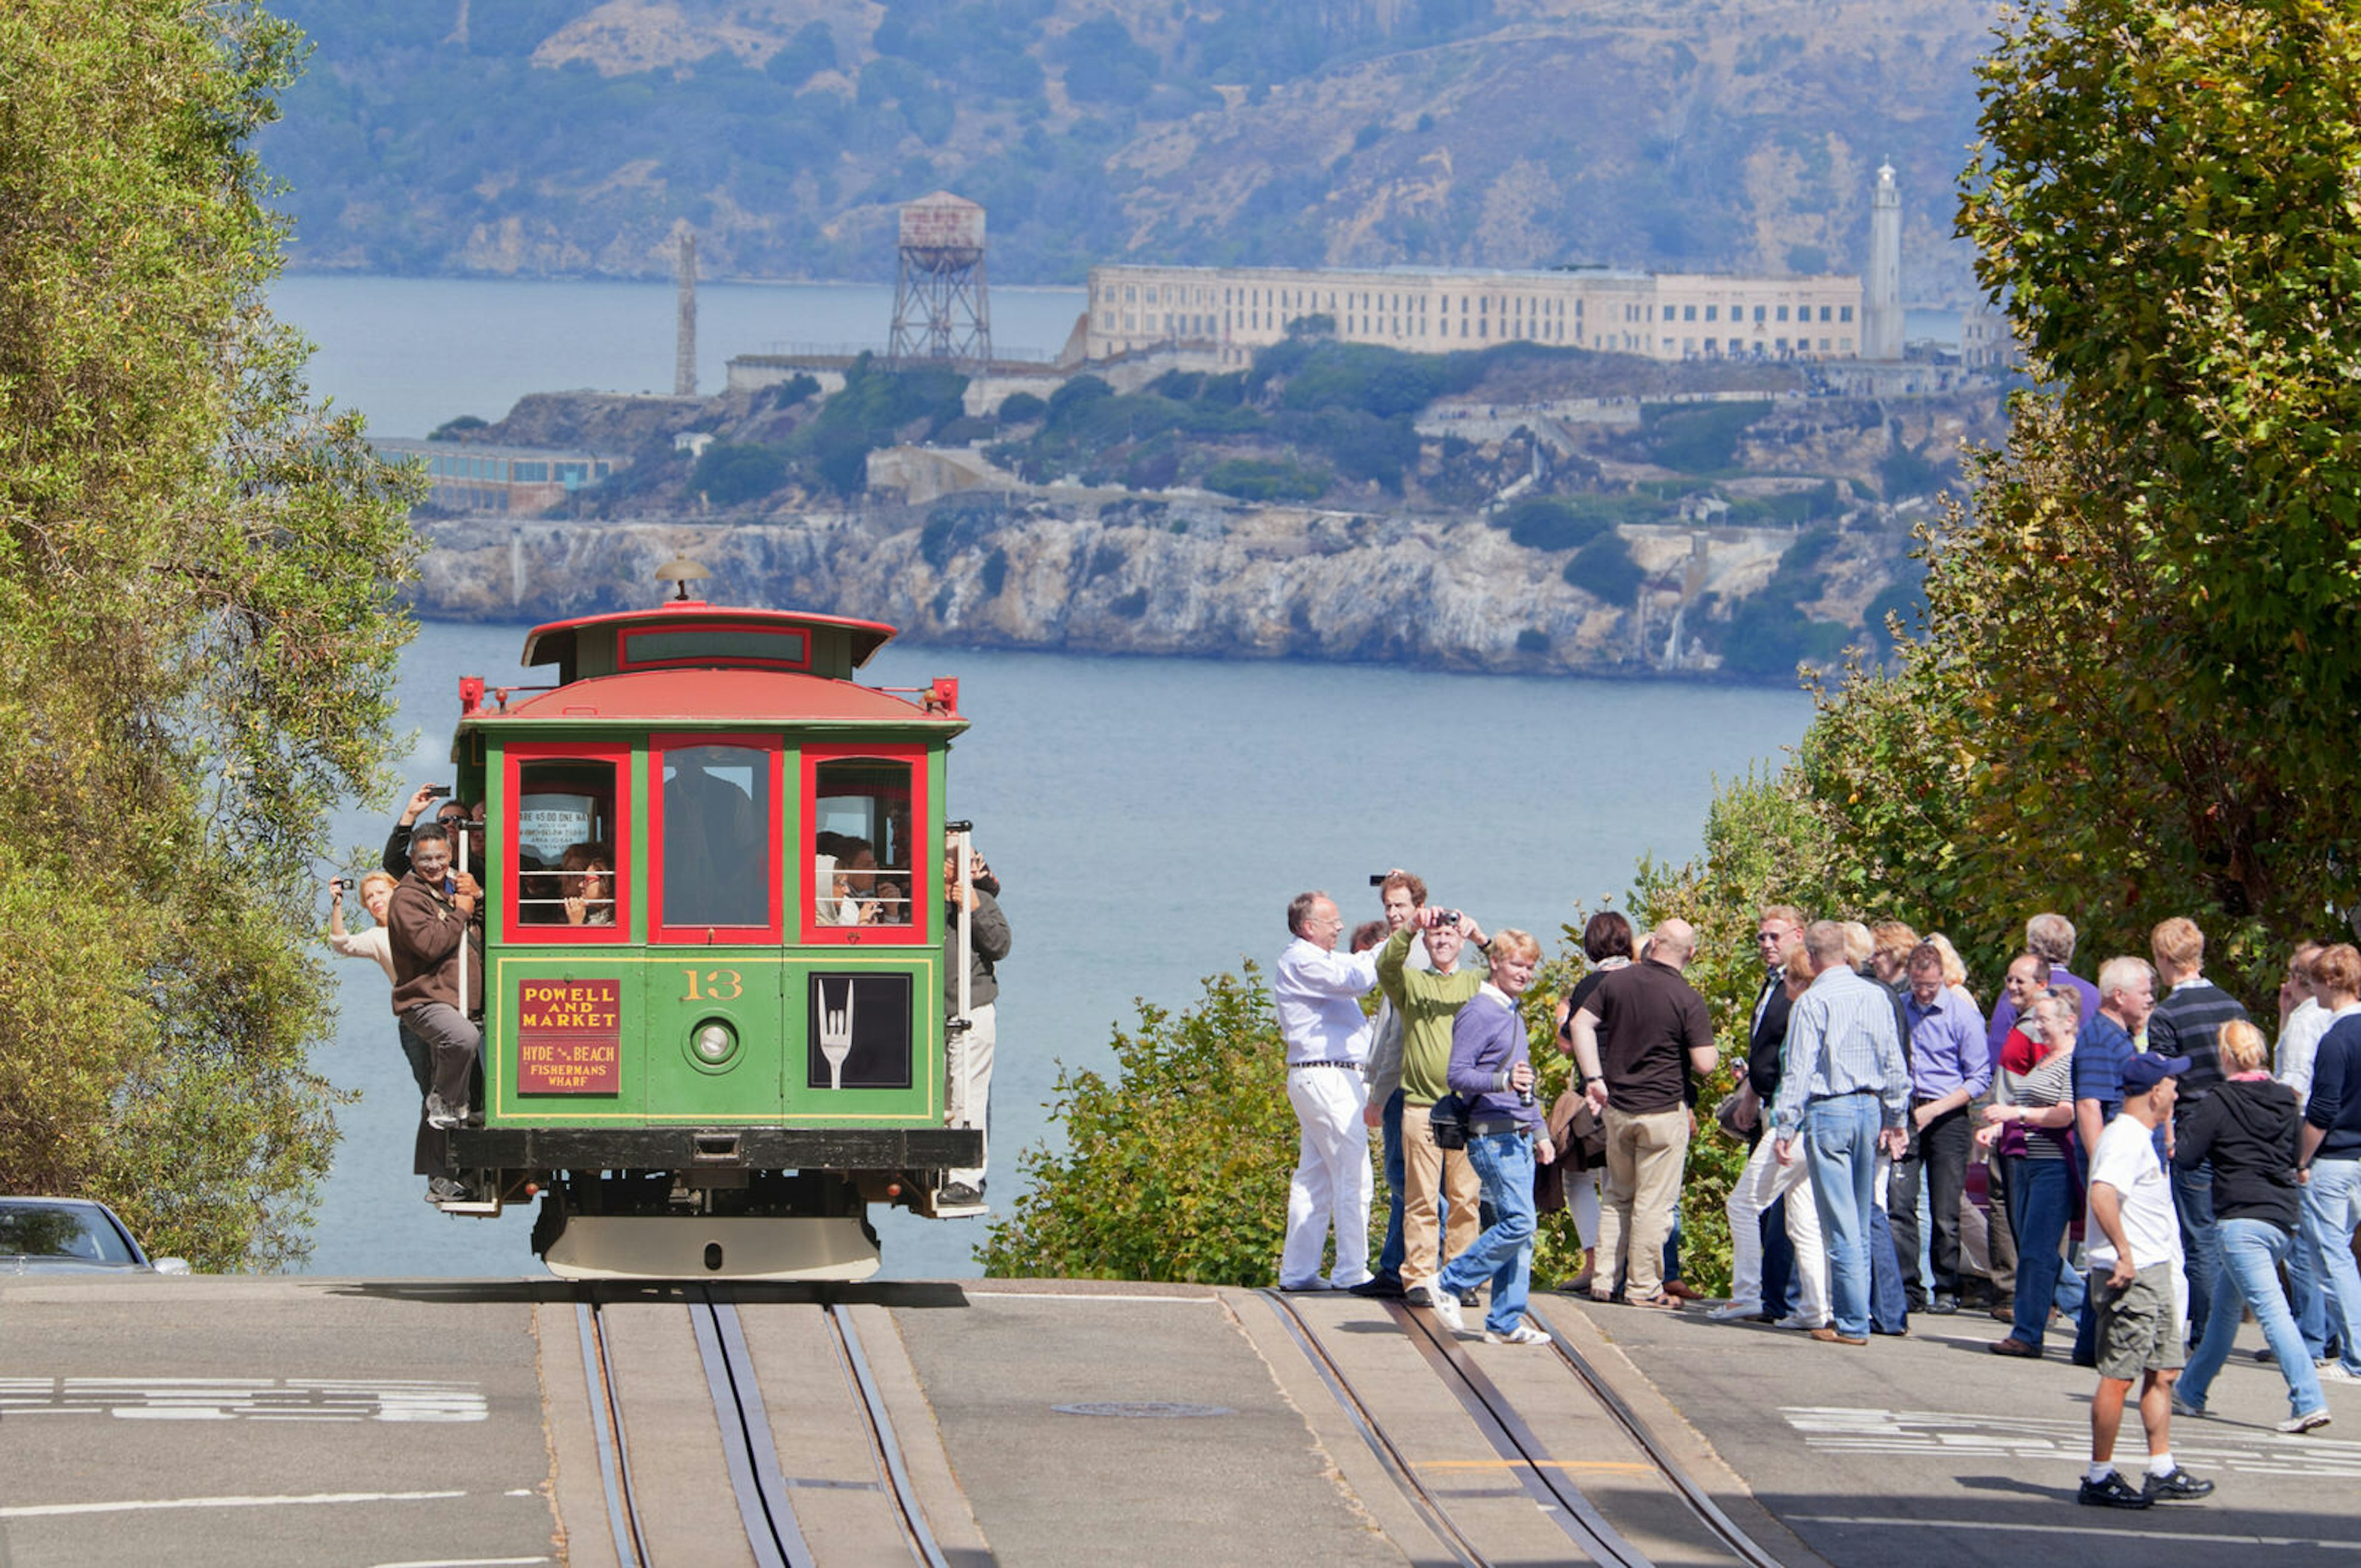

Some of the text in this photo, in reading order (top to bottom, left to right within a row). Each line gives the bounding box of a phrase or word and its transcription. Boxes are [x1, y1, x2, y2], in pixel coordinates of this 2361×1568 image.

[560, 813, 572, 822] ONE
[681, 969, 743, 1001] 13
[524, 987, 614, 1001] POWELL
[548, 1002, 593, 1012] AND
[523, 1014, 615, 1026] MARKET
[523, 1046, 554, 1061] HYDE
[573, 1046, 614, 1062] BEACH
[530, 1064, 607, 1076] FISHERMANS
[548, 1076, 588, 1087] WHARF
